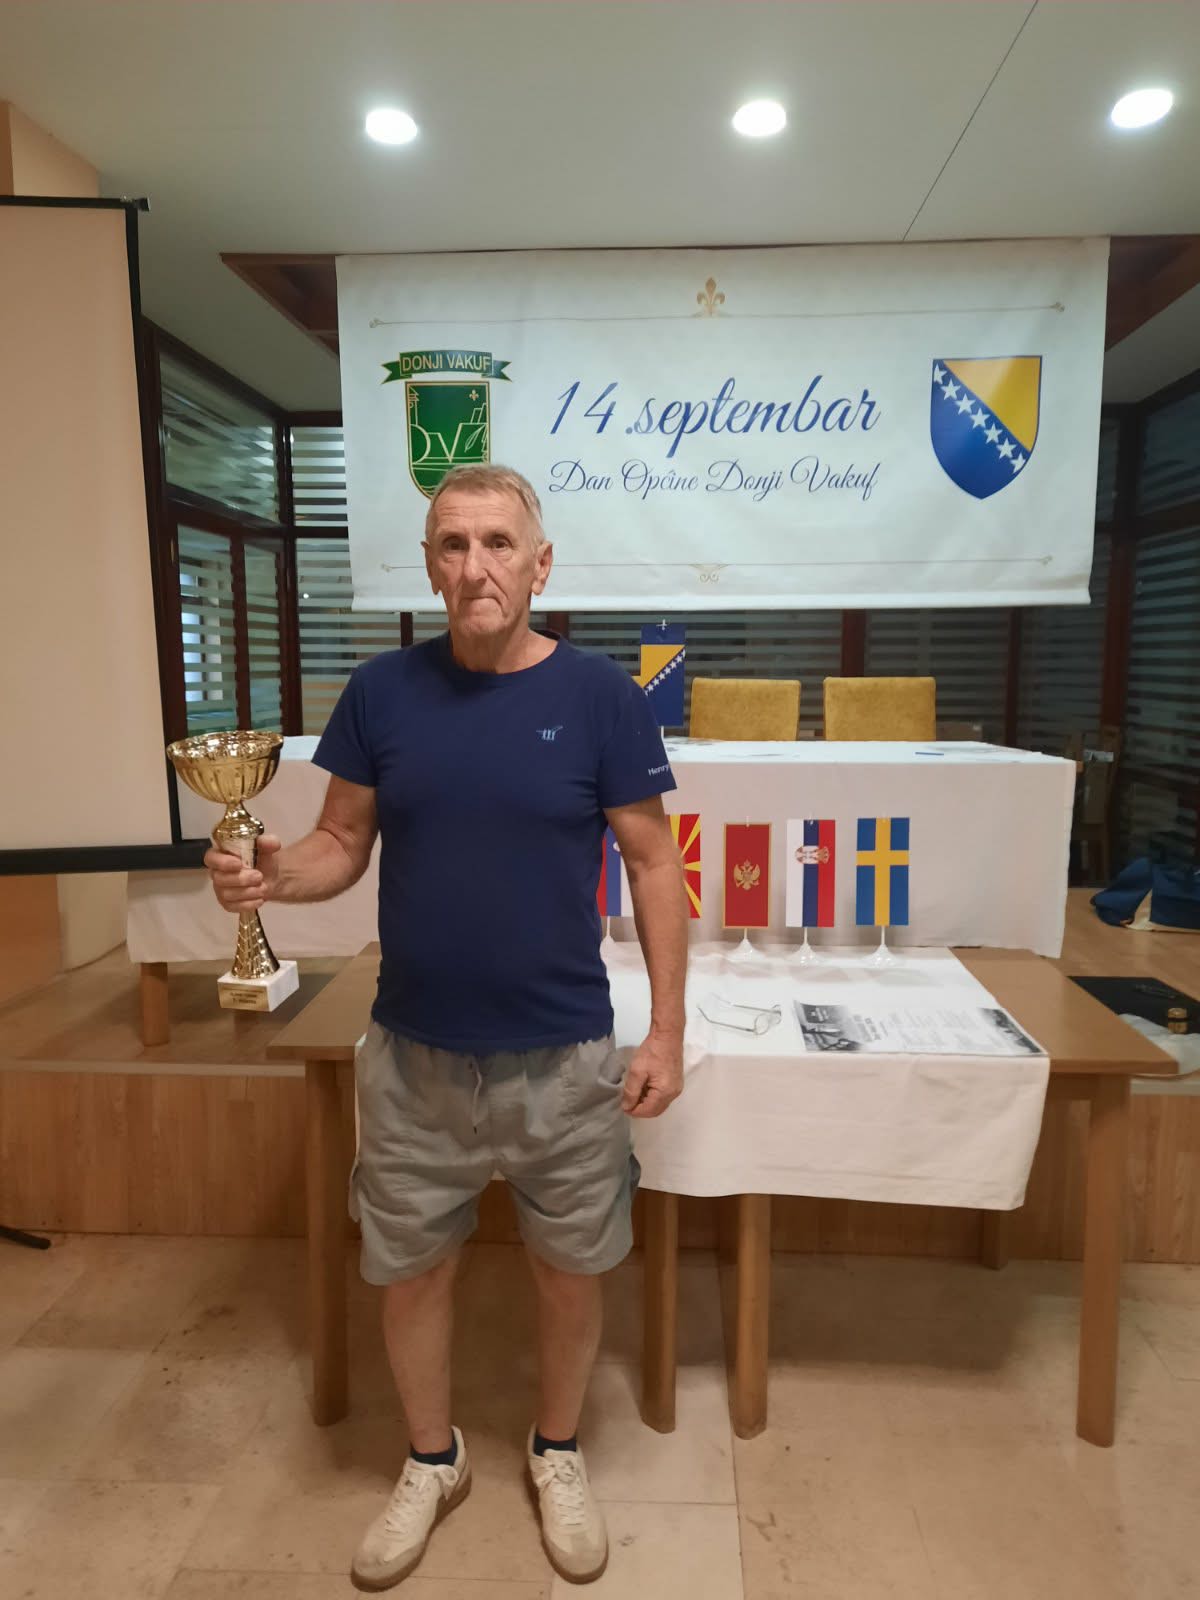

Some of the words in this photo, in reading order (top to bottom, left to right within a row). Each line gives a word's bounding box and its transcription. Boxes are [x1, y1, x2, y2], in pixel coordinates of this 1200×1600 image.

[402, 354, 443, 371] DONJI
[446, 354, 491, 371] VAKUF
[549, 458, 613, 492] Dan
[705, 458, 783, 502] Donji
[790, 455, 881, 501] Vakuf
